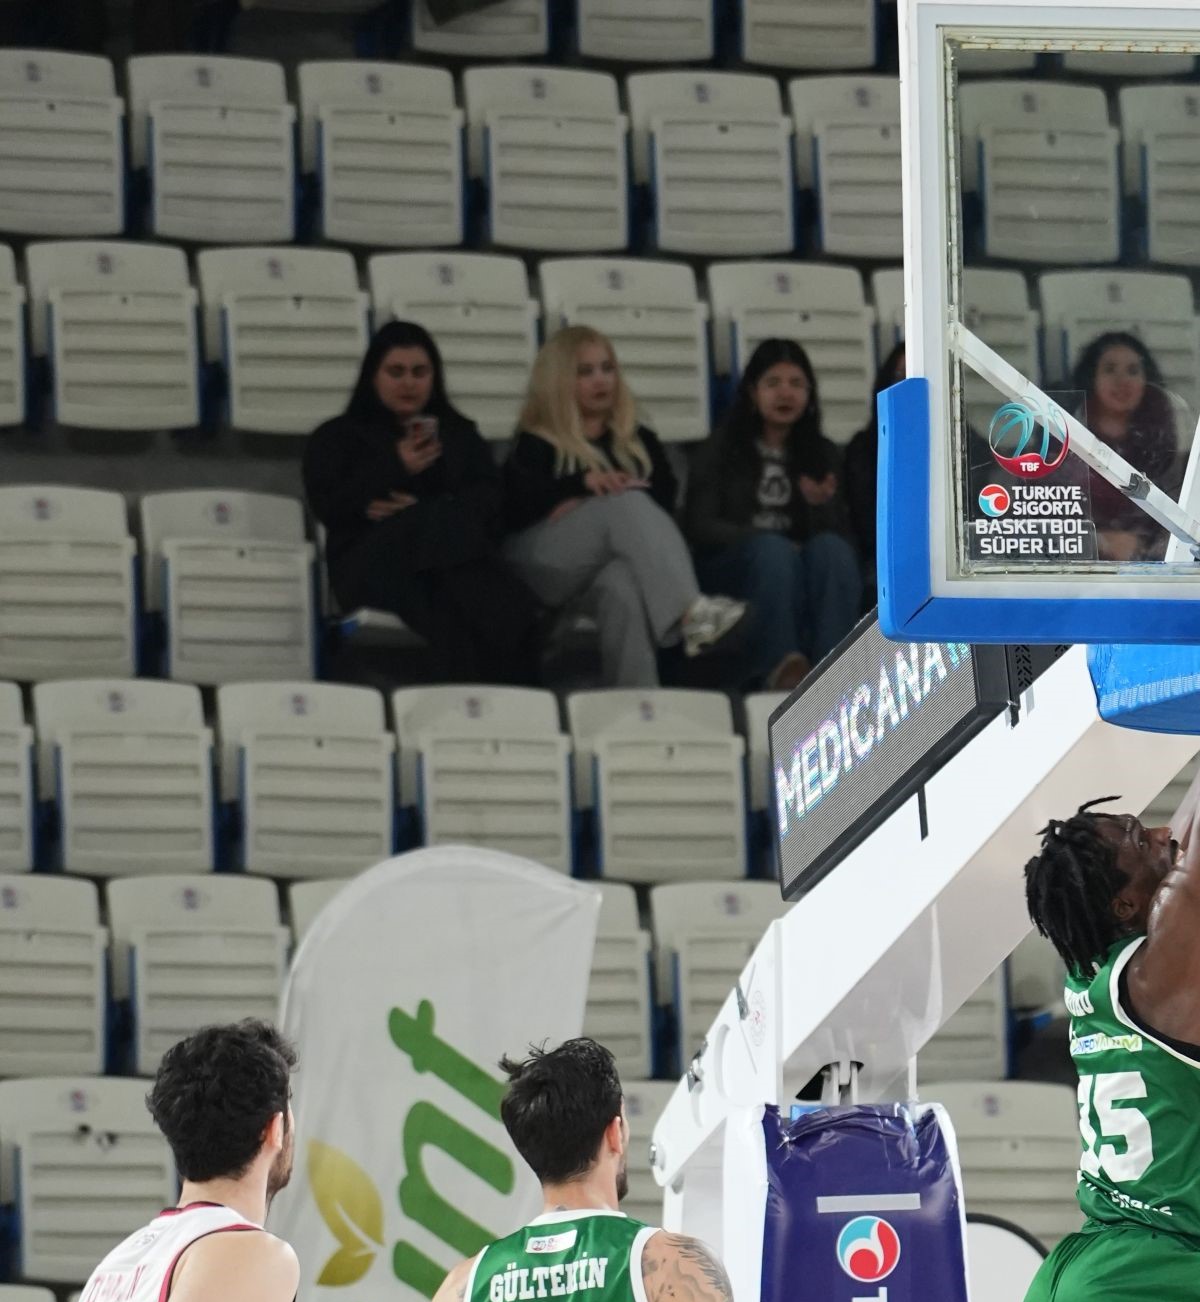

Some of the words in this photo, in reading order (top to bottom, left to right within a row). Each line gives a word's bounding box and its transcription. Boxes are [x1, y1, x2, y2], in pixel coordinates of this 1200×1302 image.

[1019, 462, 1041, 472] TBF
[975, 518, 1088, 535] BASKETBOL
[980, 536, 1044, 554] SÜPER
[1049, 535, 1083, 554] LİGİ
